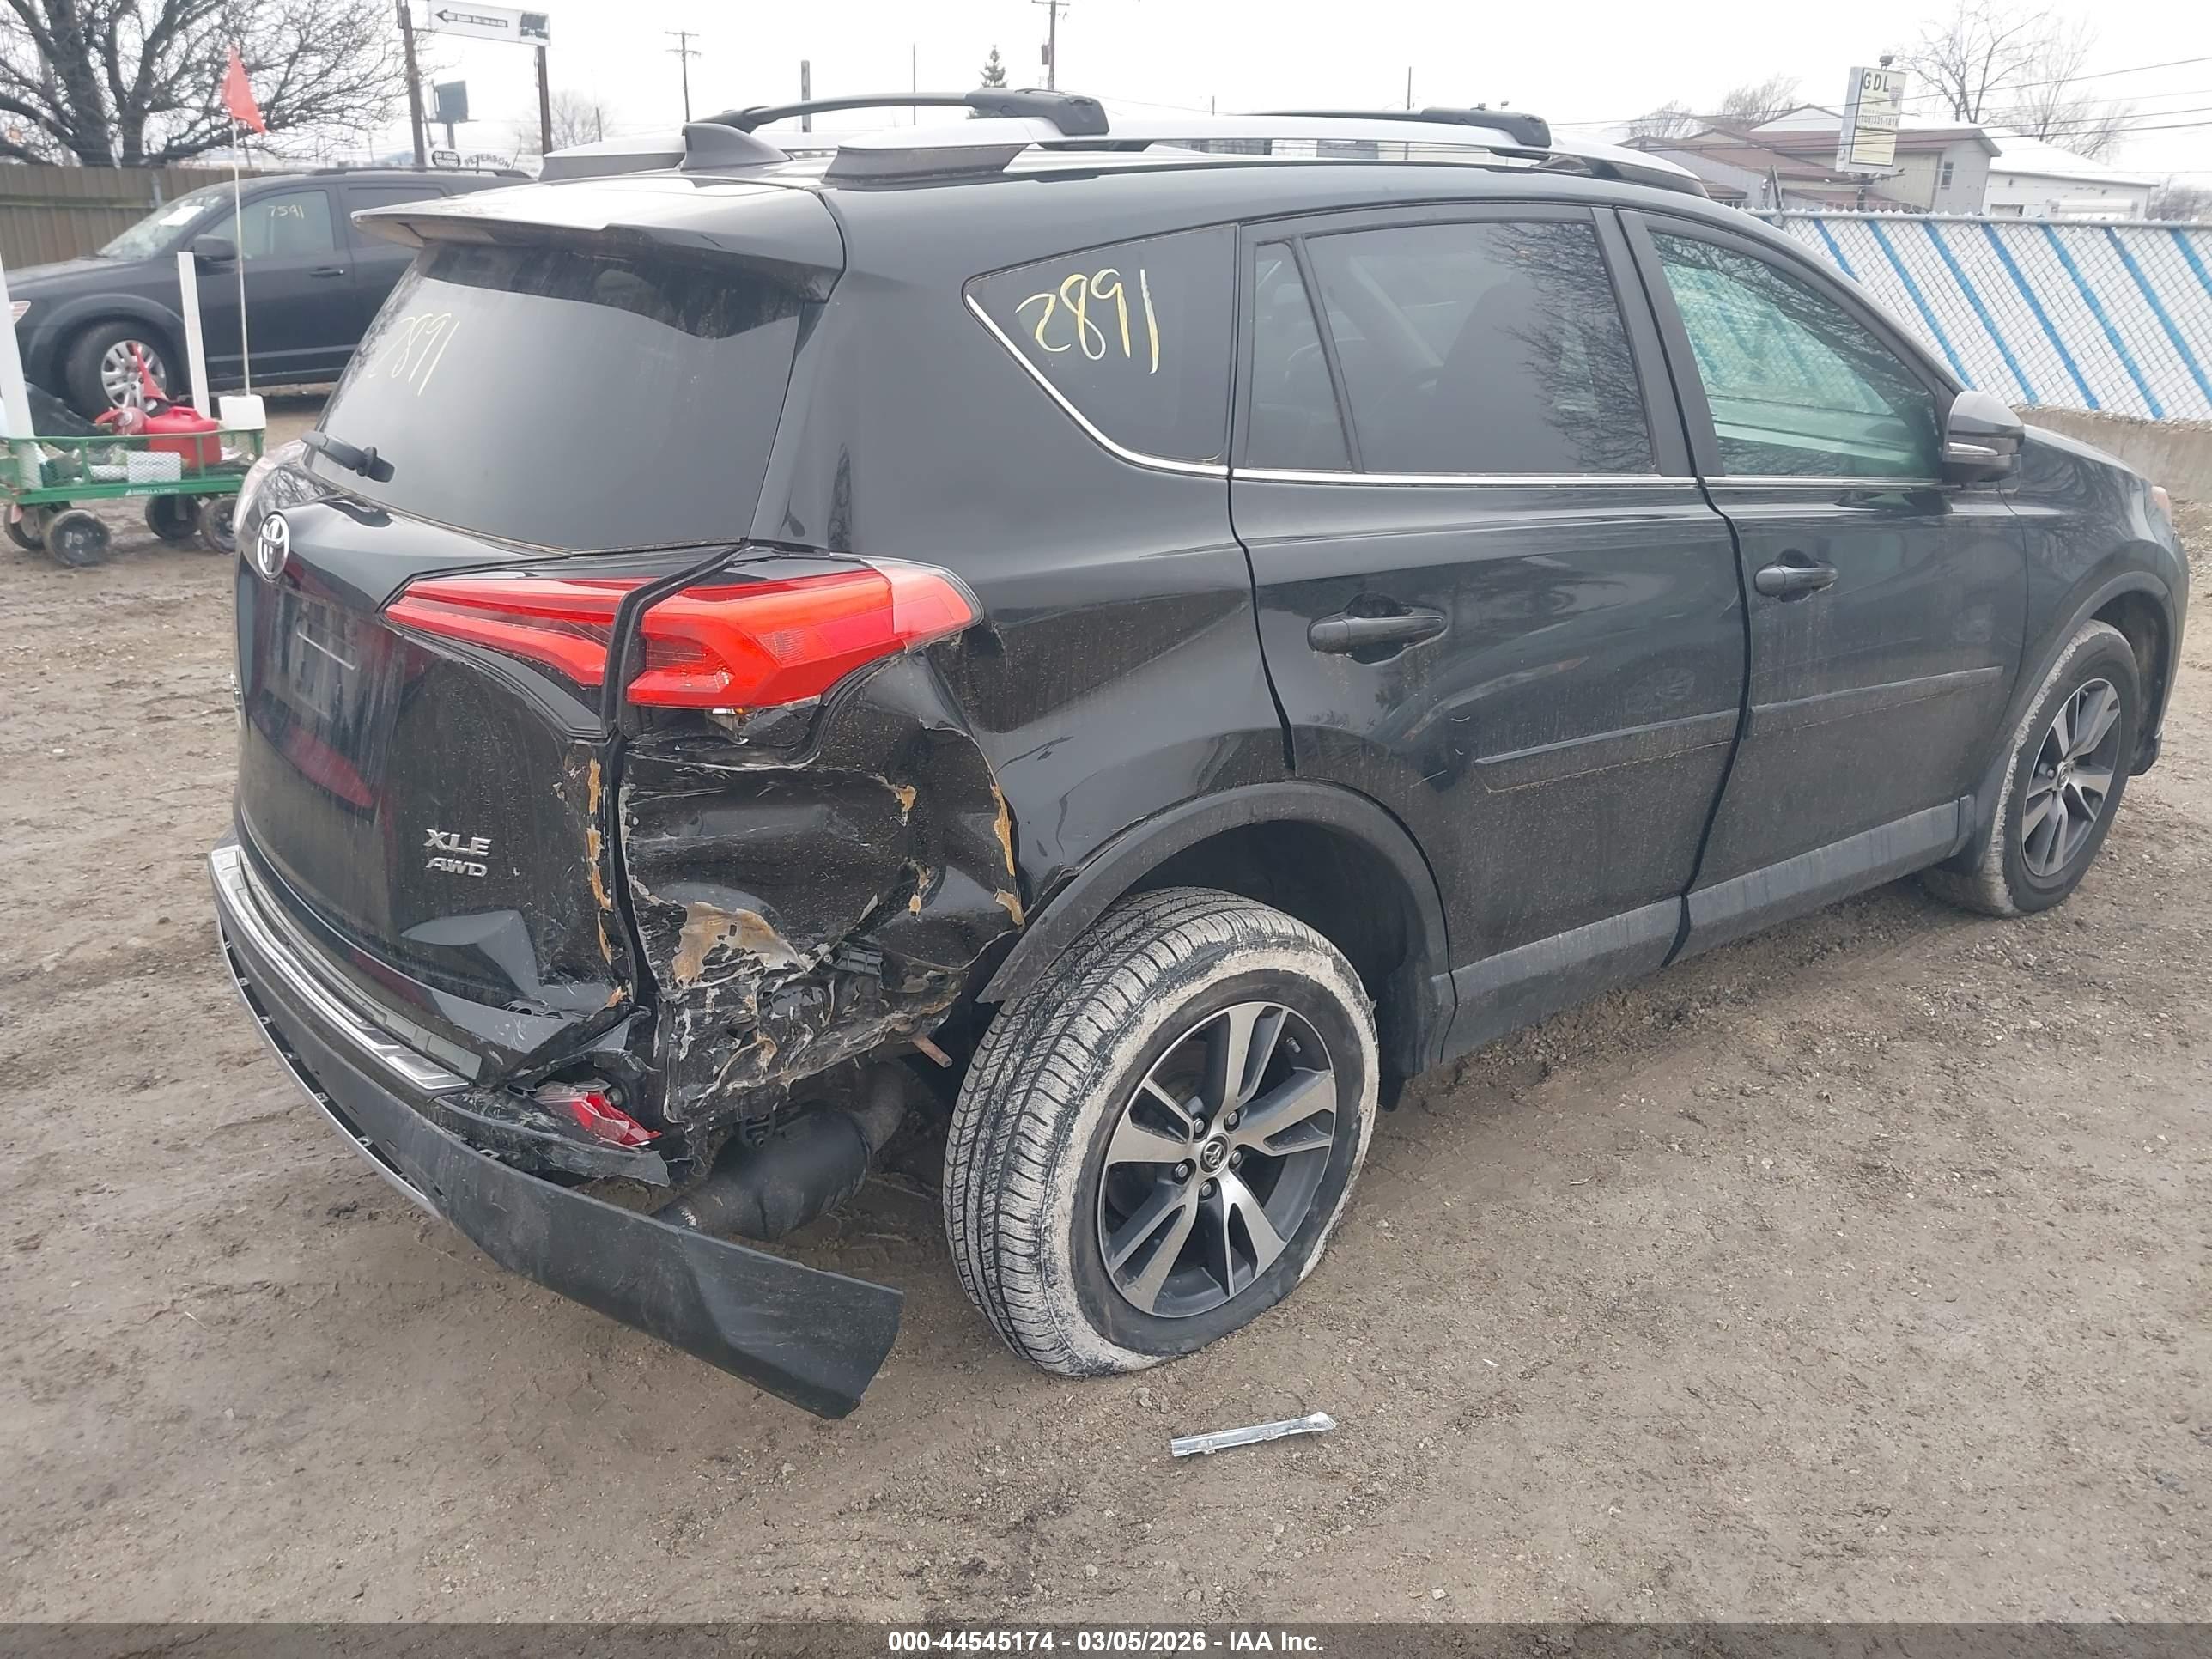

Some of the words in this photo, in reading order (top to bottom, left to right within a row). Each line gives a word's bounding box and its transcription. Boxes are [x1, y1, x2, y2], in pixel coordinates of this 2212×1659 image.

[1863, 72, 1890, 93] GDL
[268, 204, 304, 219] 7591
[1015, 268, 1159, 374] 2891
[423, 829, 492, 856] XLE
[426, 857, 488, 878] AWD
